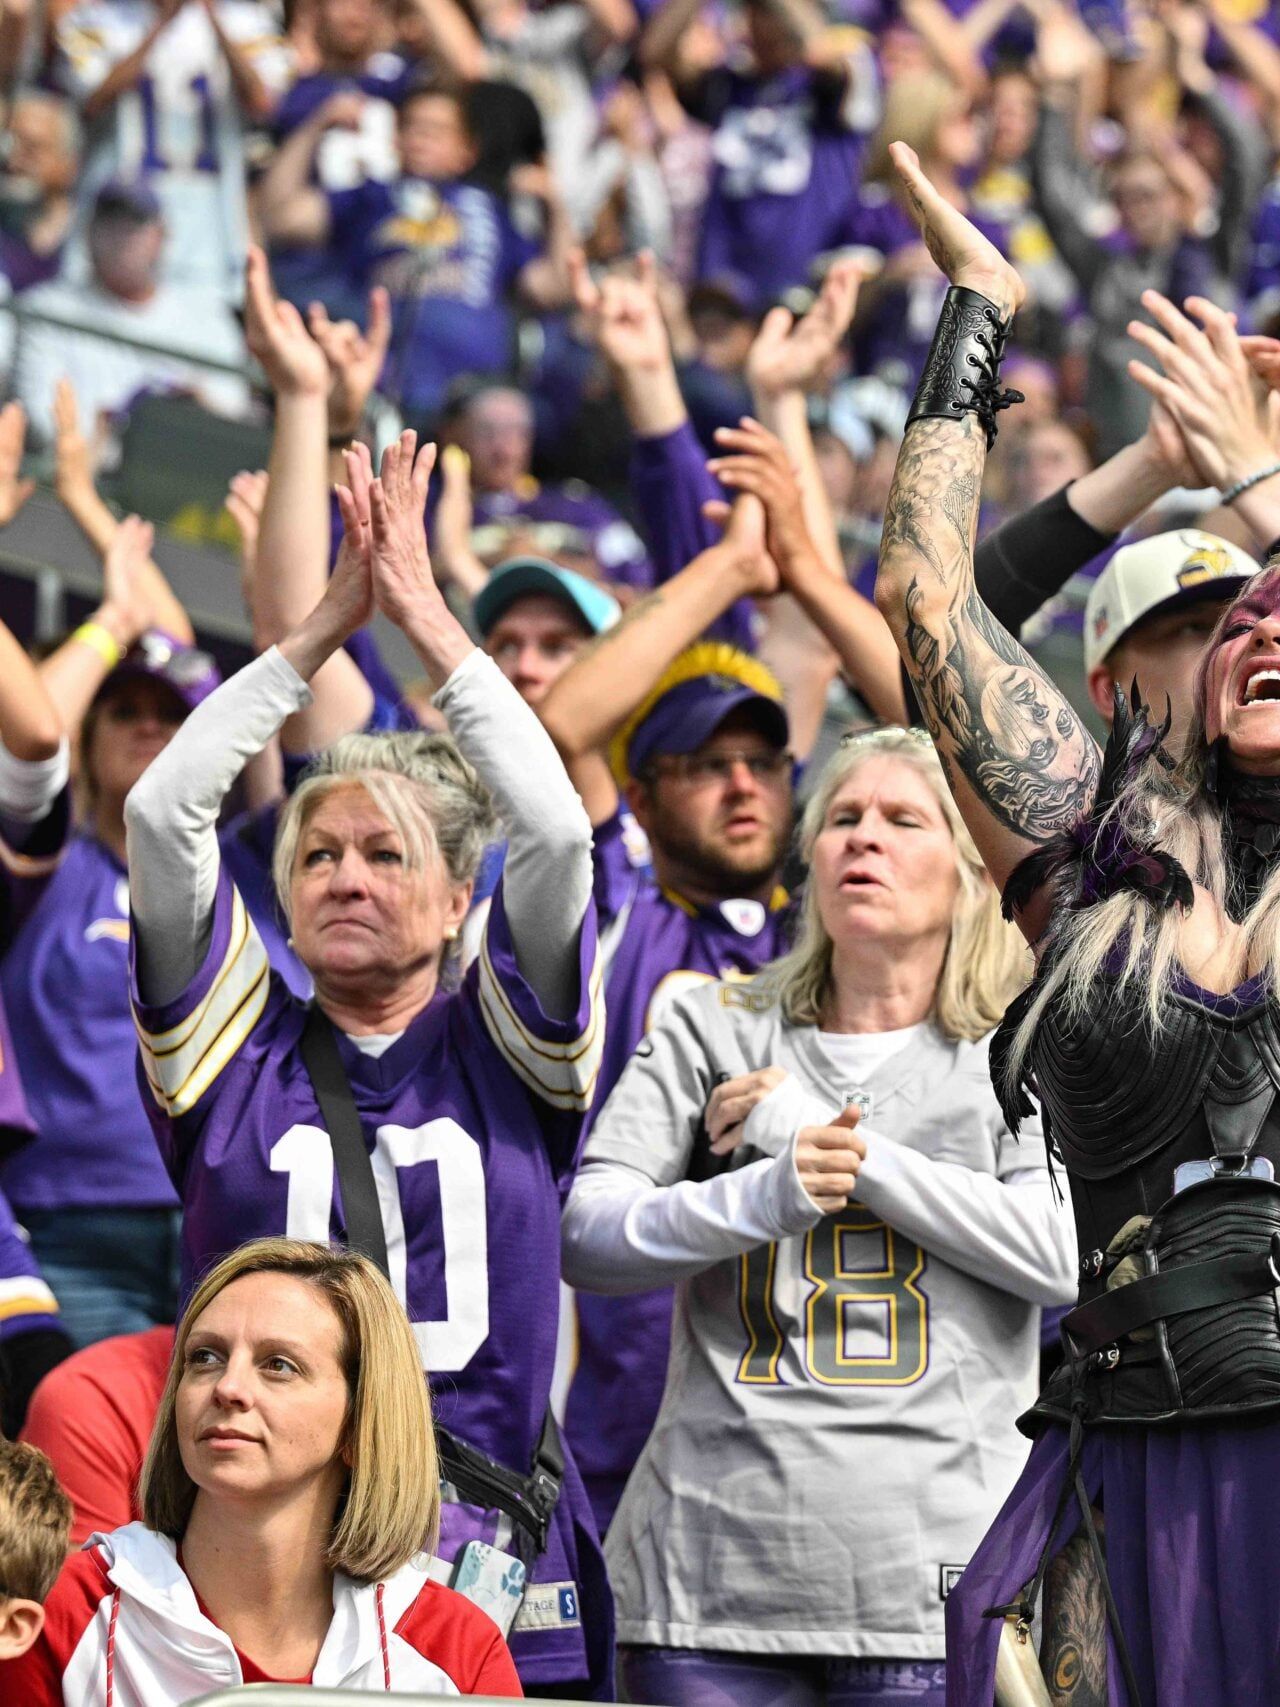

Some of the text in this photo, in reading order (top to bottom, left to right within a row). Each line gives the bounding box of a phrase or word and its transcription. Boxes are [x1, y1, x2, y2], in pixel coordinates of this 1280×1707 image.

[137, 72, 219, 173] 11
[270, 1116, 490, 1372] 10
[735, 1203, 930, 1387] 18
[522, 1593, 575, 1615] TAGE S
